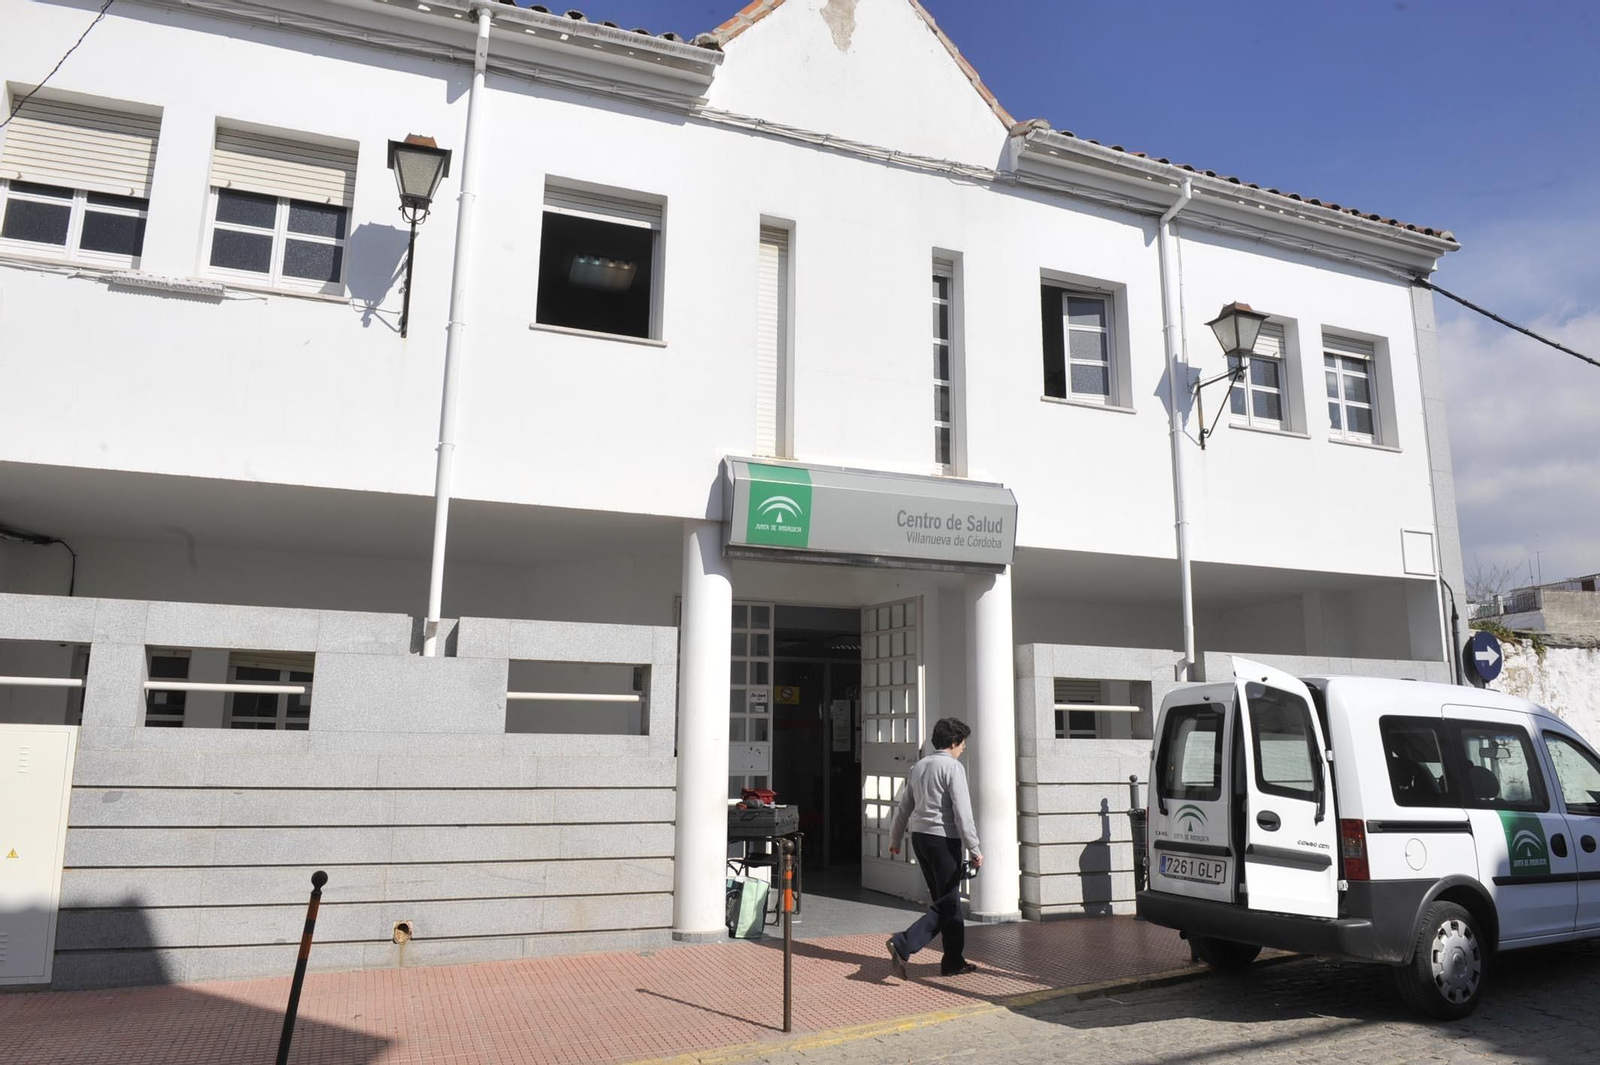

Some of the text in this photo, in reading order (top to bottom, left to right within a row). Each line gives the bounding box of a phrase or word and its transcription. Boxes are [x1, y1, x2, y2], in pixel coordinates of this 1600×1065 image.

[897, 509, 1003, 534] Centro de Salud
[906, 531, 1002, 548] Villanueva de Córdoba
[1166, 857, 1194, 876] 7261
[1198, 862, 1223, 879] GLP
